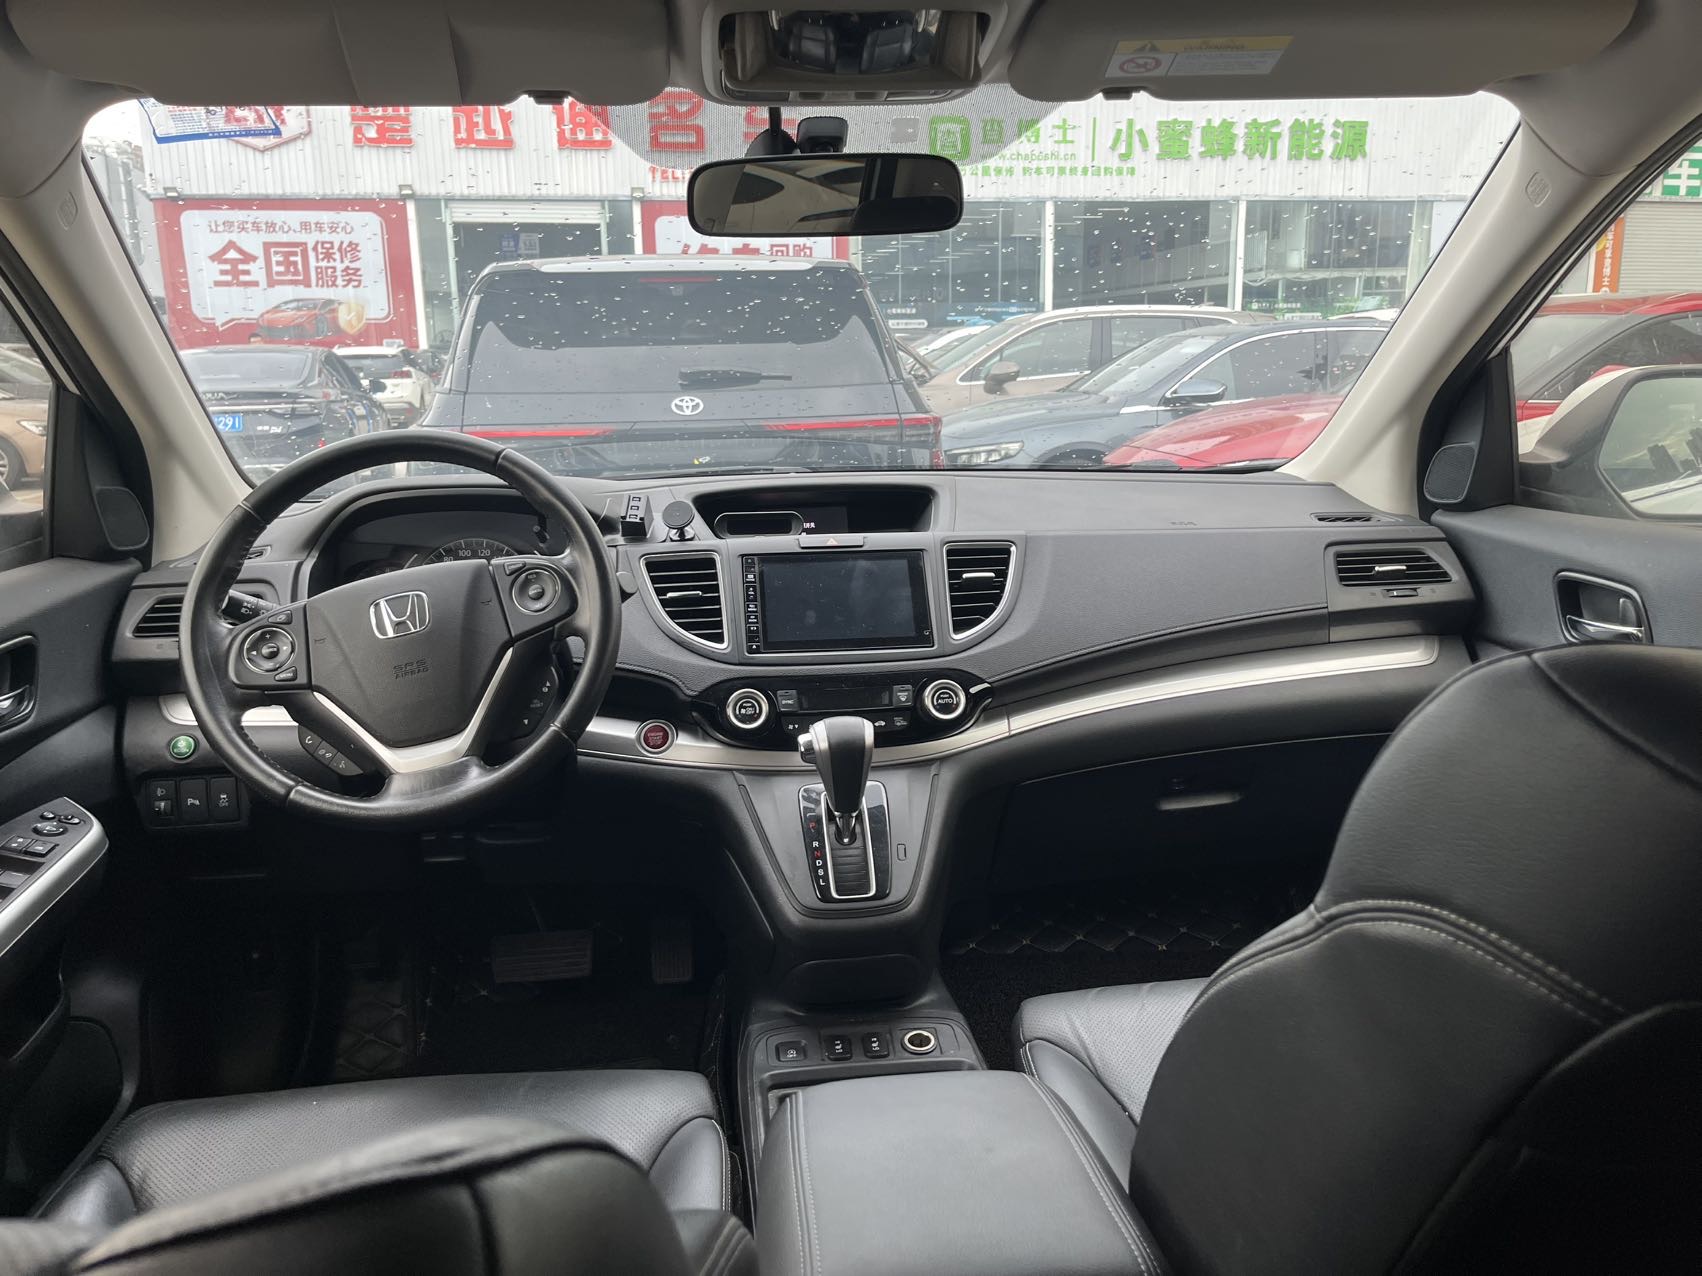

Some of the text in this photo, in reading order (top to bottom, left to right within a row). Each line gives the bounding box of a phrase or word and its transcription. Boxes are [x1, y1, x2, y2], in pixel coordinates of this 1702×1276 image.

[1109, 117, 1370, 161] 小蜜蜂新能源
[206, 219, 355, 236] 让您买车放心、用车安心
[311, 239, 362, 264] 保修
[207, 239, 313, 289] 全国
[314, 265, 363, 289] 服务
[458, 549, 472, 557] 100
[477, 549, 491, 557] 120
